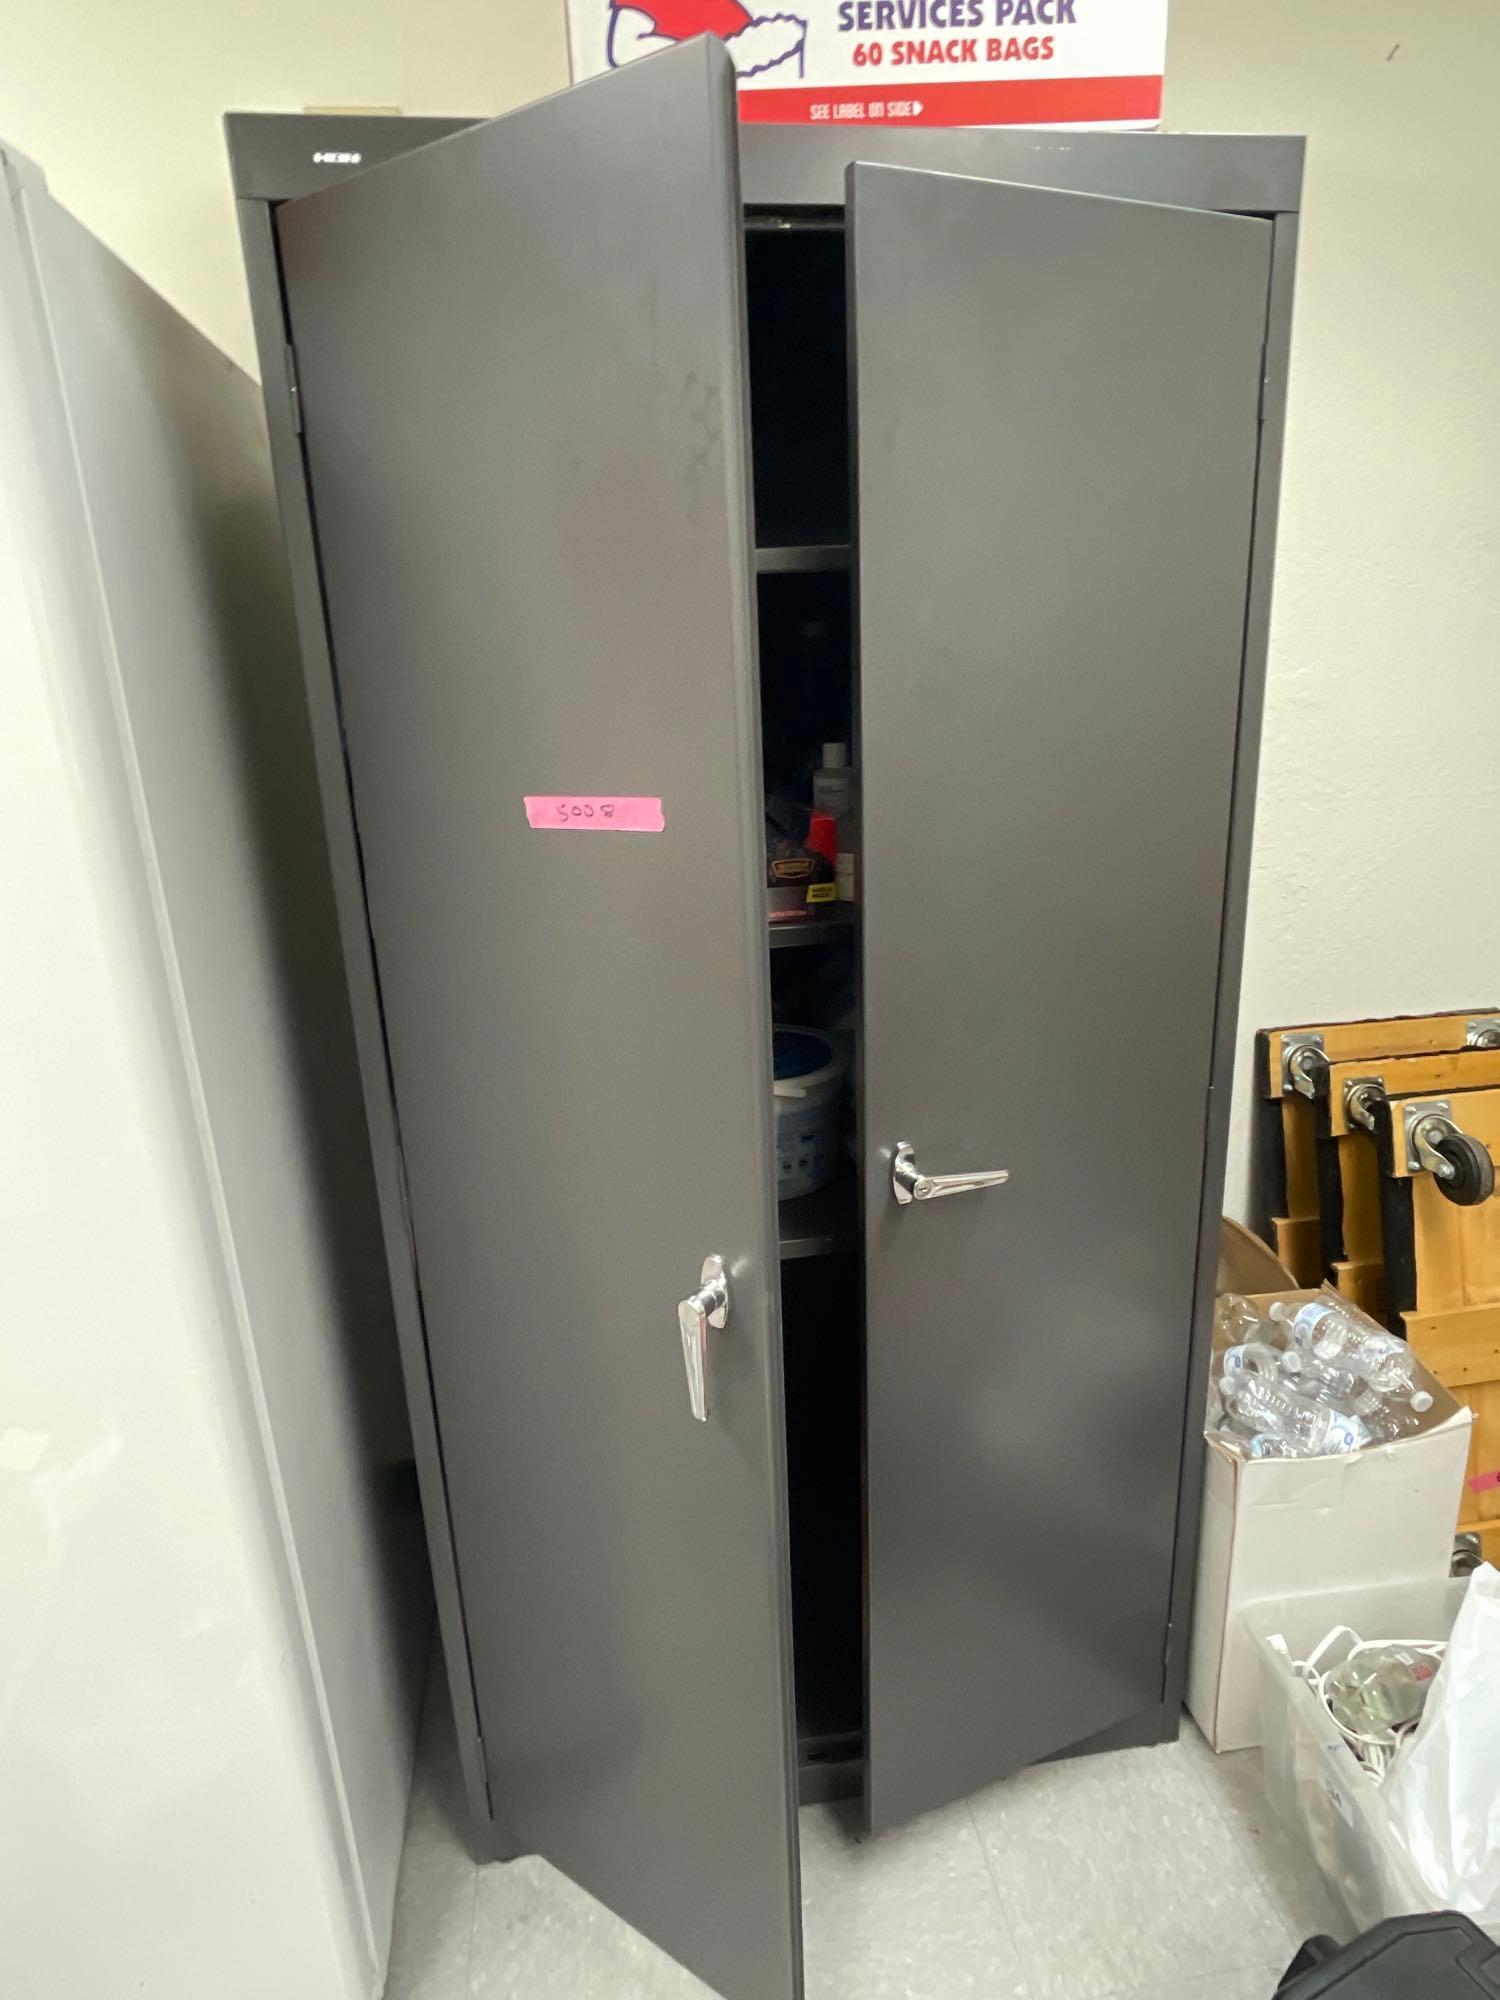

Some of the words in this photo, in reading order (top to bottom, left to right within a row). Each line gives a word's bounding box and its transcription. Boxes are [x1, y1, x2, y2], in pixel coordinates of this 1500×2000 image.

[838, 0, 984, 31] SERVICES
[996, 0, 1076, 26] PACK
[852, 42, 883, 67] 60
[891, 39, 978, 66] SNACK
[986, 35, 1055, 62] BAGS
[810, 103, 830, 120] SEE
[833, 102, 865, 119] LABEL
[868, 101, 884, 117] ON
[887, 100, 912, 117] SIDE
